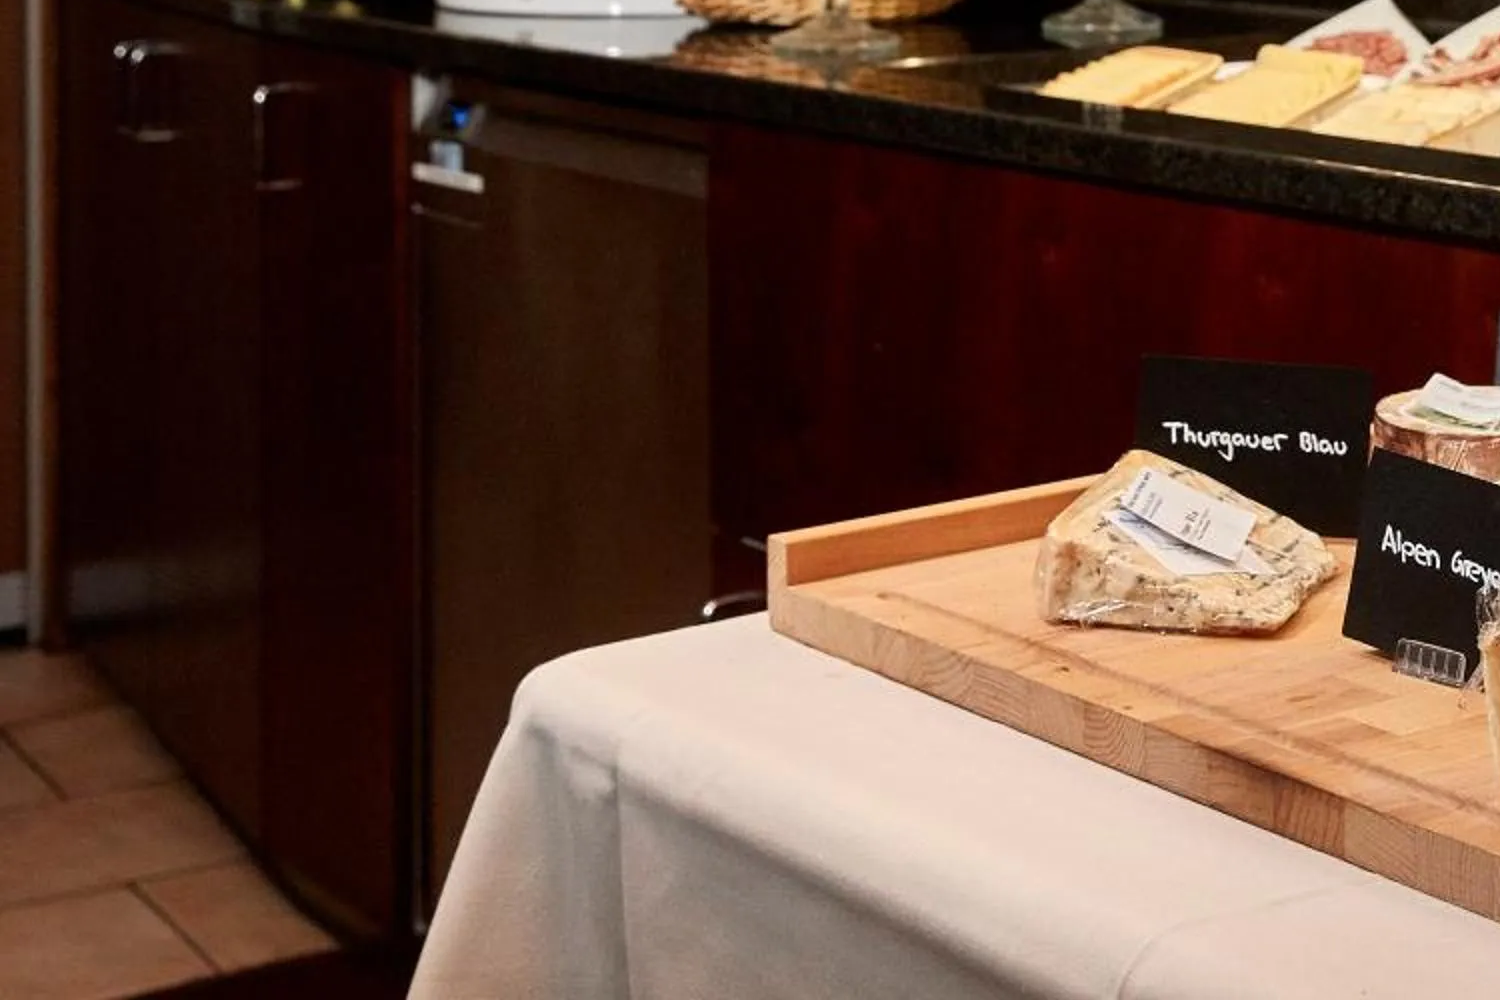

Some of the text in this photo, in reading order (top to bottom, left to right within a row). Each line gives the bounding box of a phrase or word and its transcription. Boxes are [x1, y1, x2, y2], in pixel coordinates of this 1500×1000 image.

[1161, 420, 1349, 463] Thurgauer Blau
[1381, 523, 1441, 570] Alpen
